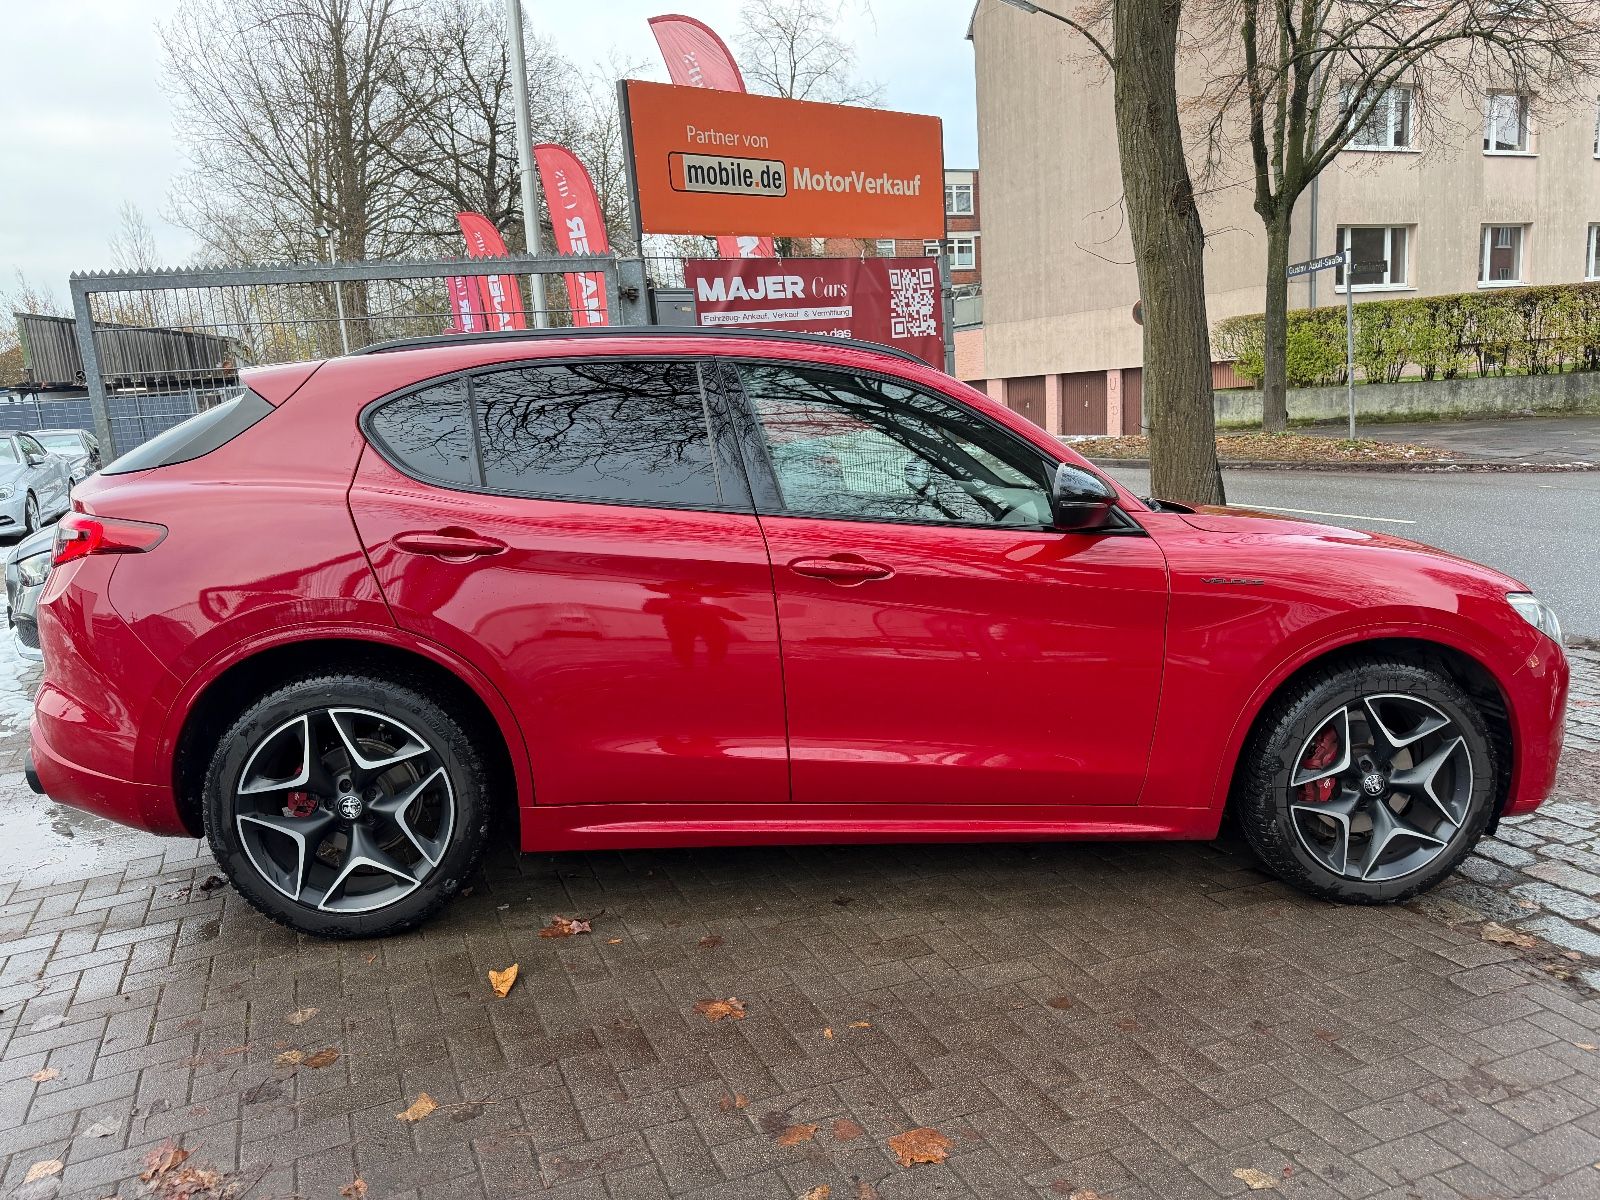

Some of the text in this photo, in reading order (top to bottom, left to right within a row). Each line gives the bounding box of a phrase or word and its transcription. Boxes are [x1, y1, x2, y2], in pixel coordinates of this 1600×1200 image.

[686, 125, 769, 149] Partner von
[686, 161, 921, 196] mobile.de MotorVerkauf
[696, 275, 848, 302] MAJER Cars
[703, 314, 741, 323] Fahrzeug-
[773, 311, 799, 319] Verkauf
[812, 308, 850, 317] Vermittlung
